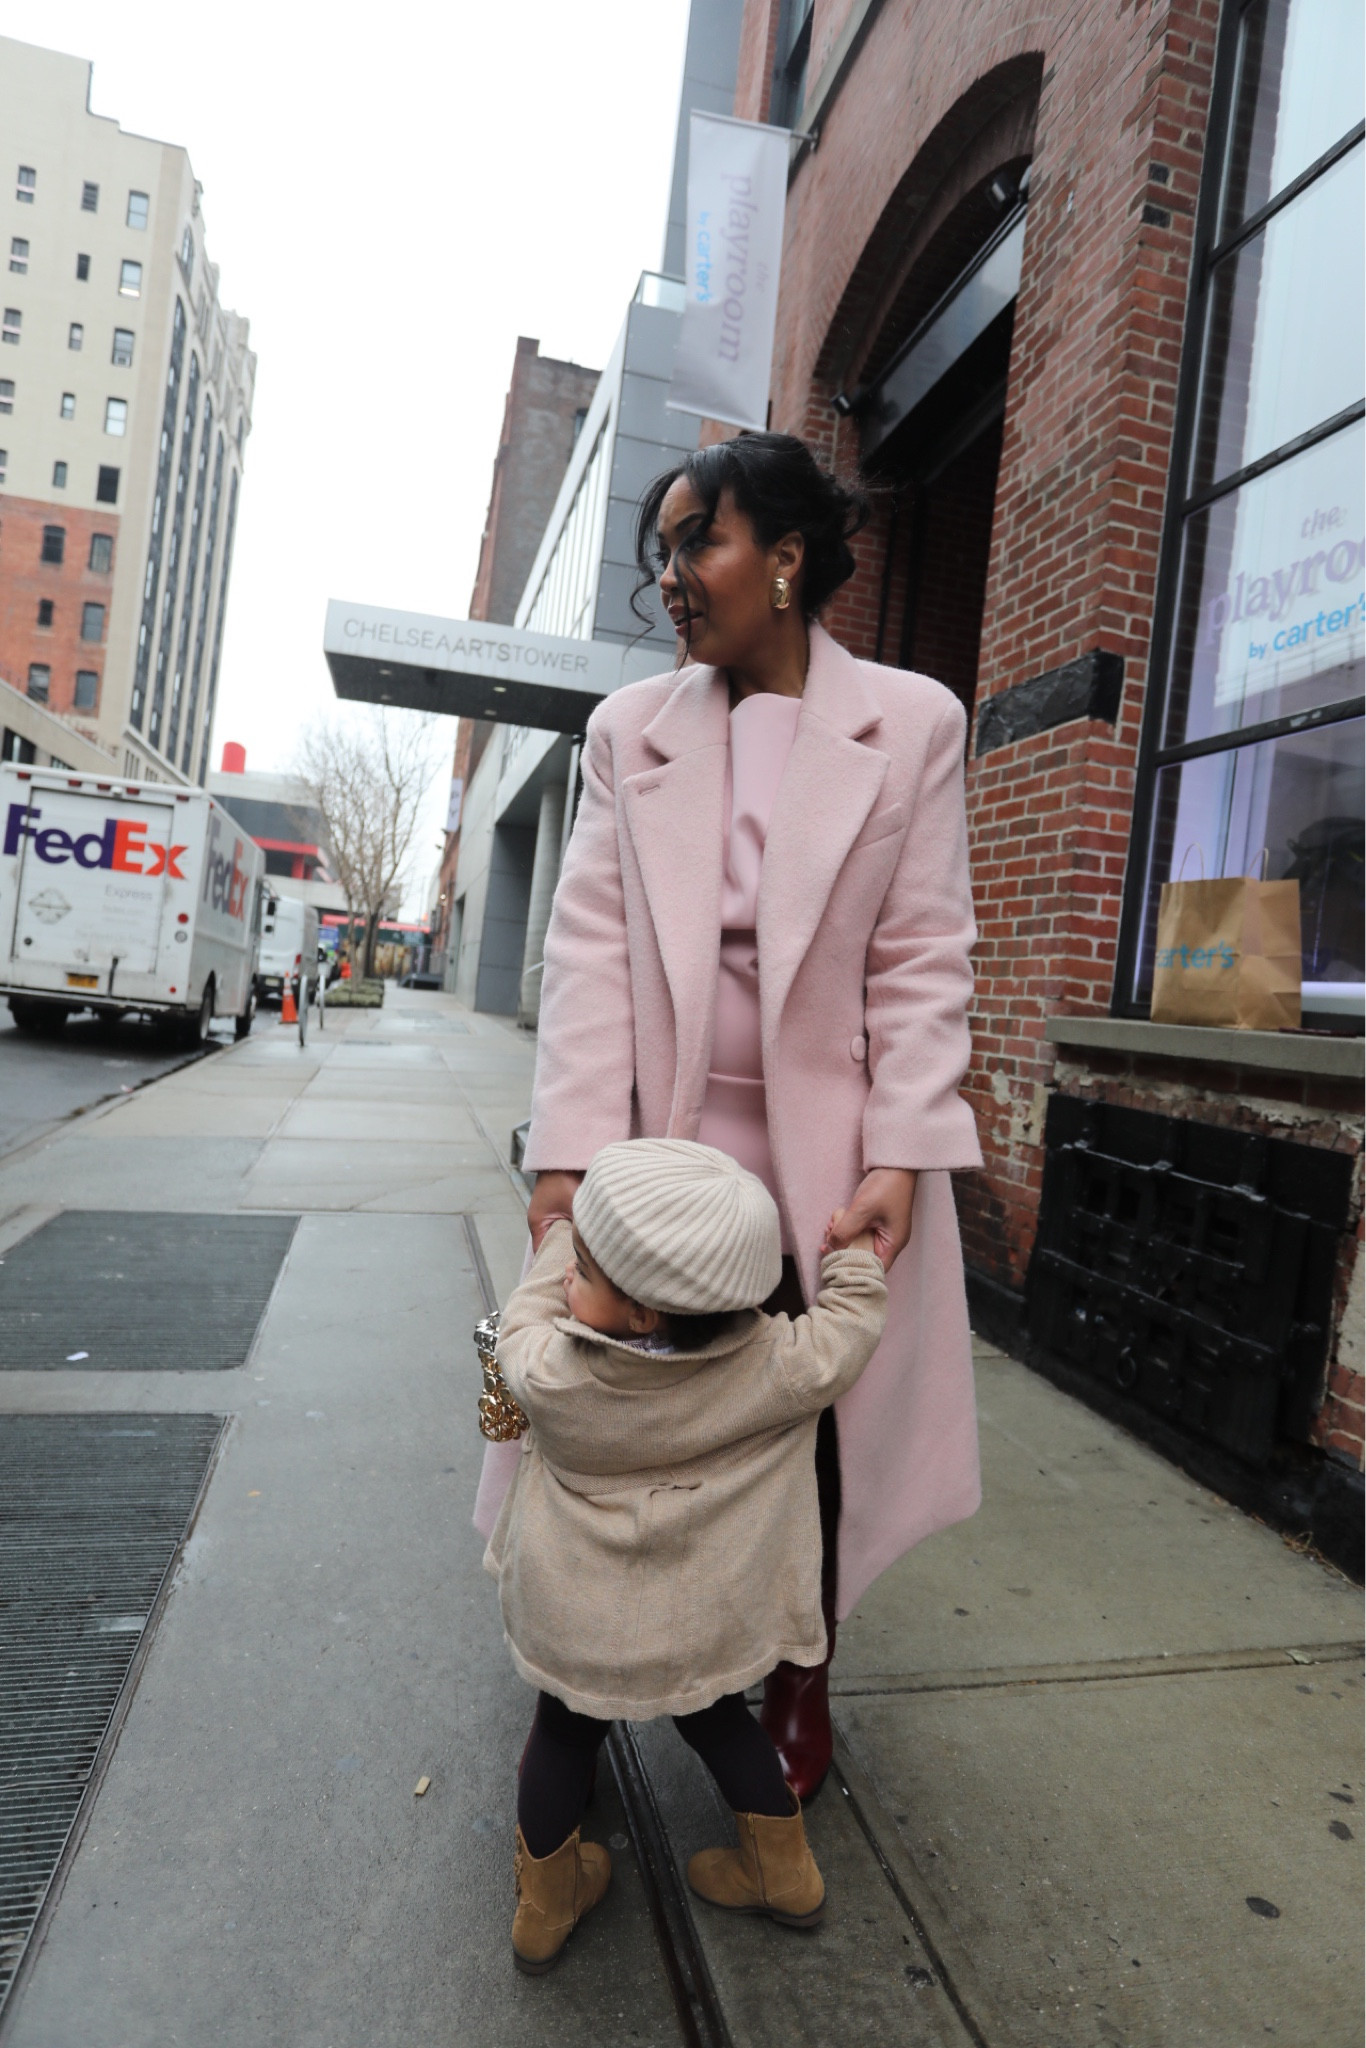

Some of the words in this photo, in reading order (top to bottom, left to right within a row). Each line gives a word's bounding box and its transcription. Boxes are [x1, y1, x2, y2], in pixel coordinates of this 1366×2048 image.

[696, 230, 714, 302] carter's
[718, 172, 759, 363] playroom
[756, 261, 770, 296] the
[1301, 506, 1342, 538] the
[1204, 537, 1365, 645] playro
[1249, 641, 1267, 660] by
[3, 803, 188, 880] FedEx
[203, 812, 248, 922] FedEx
[1156, 939, 1235, 969] arter's
